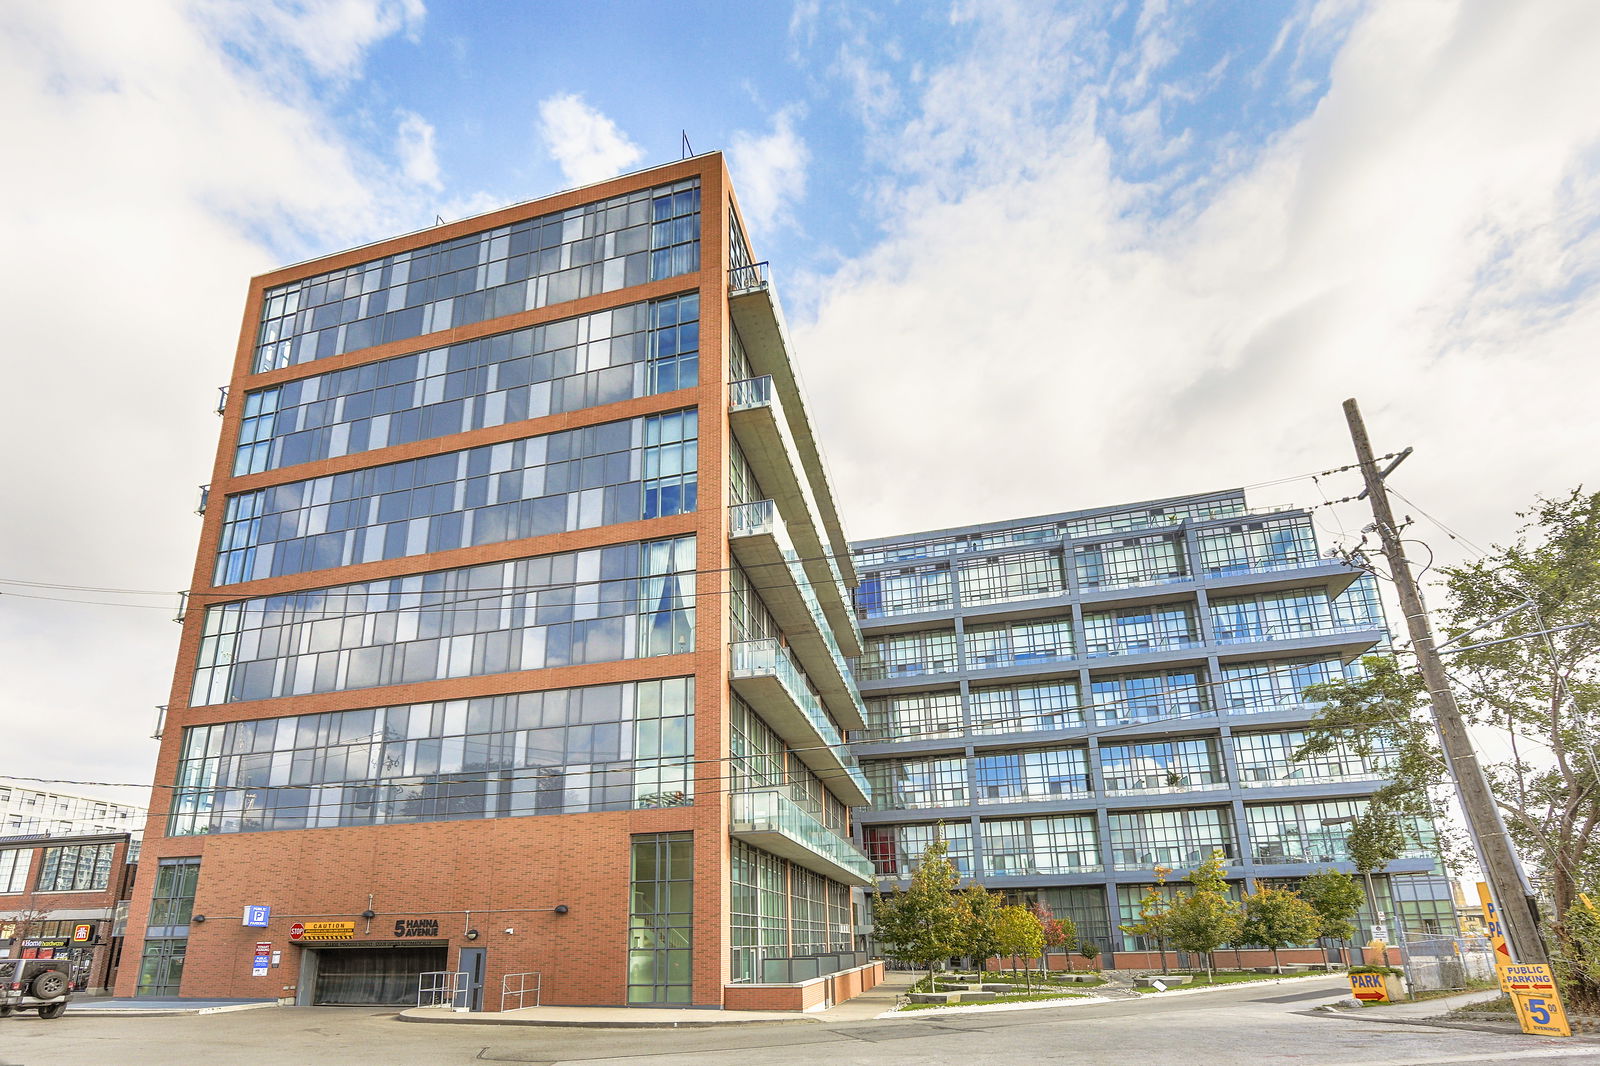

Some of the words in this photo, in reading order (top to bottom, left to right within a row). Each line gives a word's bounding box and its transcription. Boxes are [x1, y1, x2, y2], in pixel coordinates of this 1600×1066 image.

[394, 919, 406, 937] 5
[406, 919, 439, 928] HANNA
[405, 927, 439, 937] AVENUE
[1507, 966, 1544, 975] PUBLIC
[1351, 975, 1383, 988] PARK
[1507, 975, 1551, 983] PARKING
